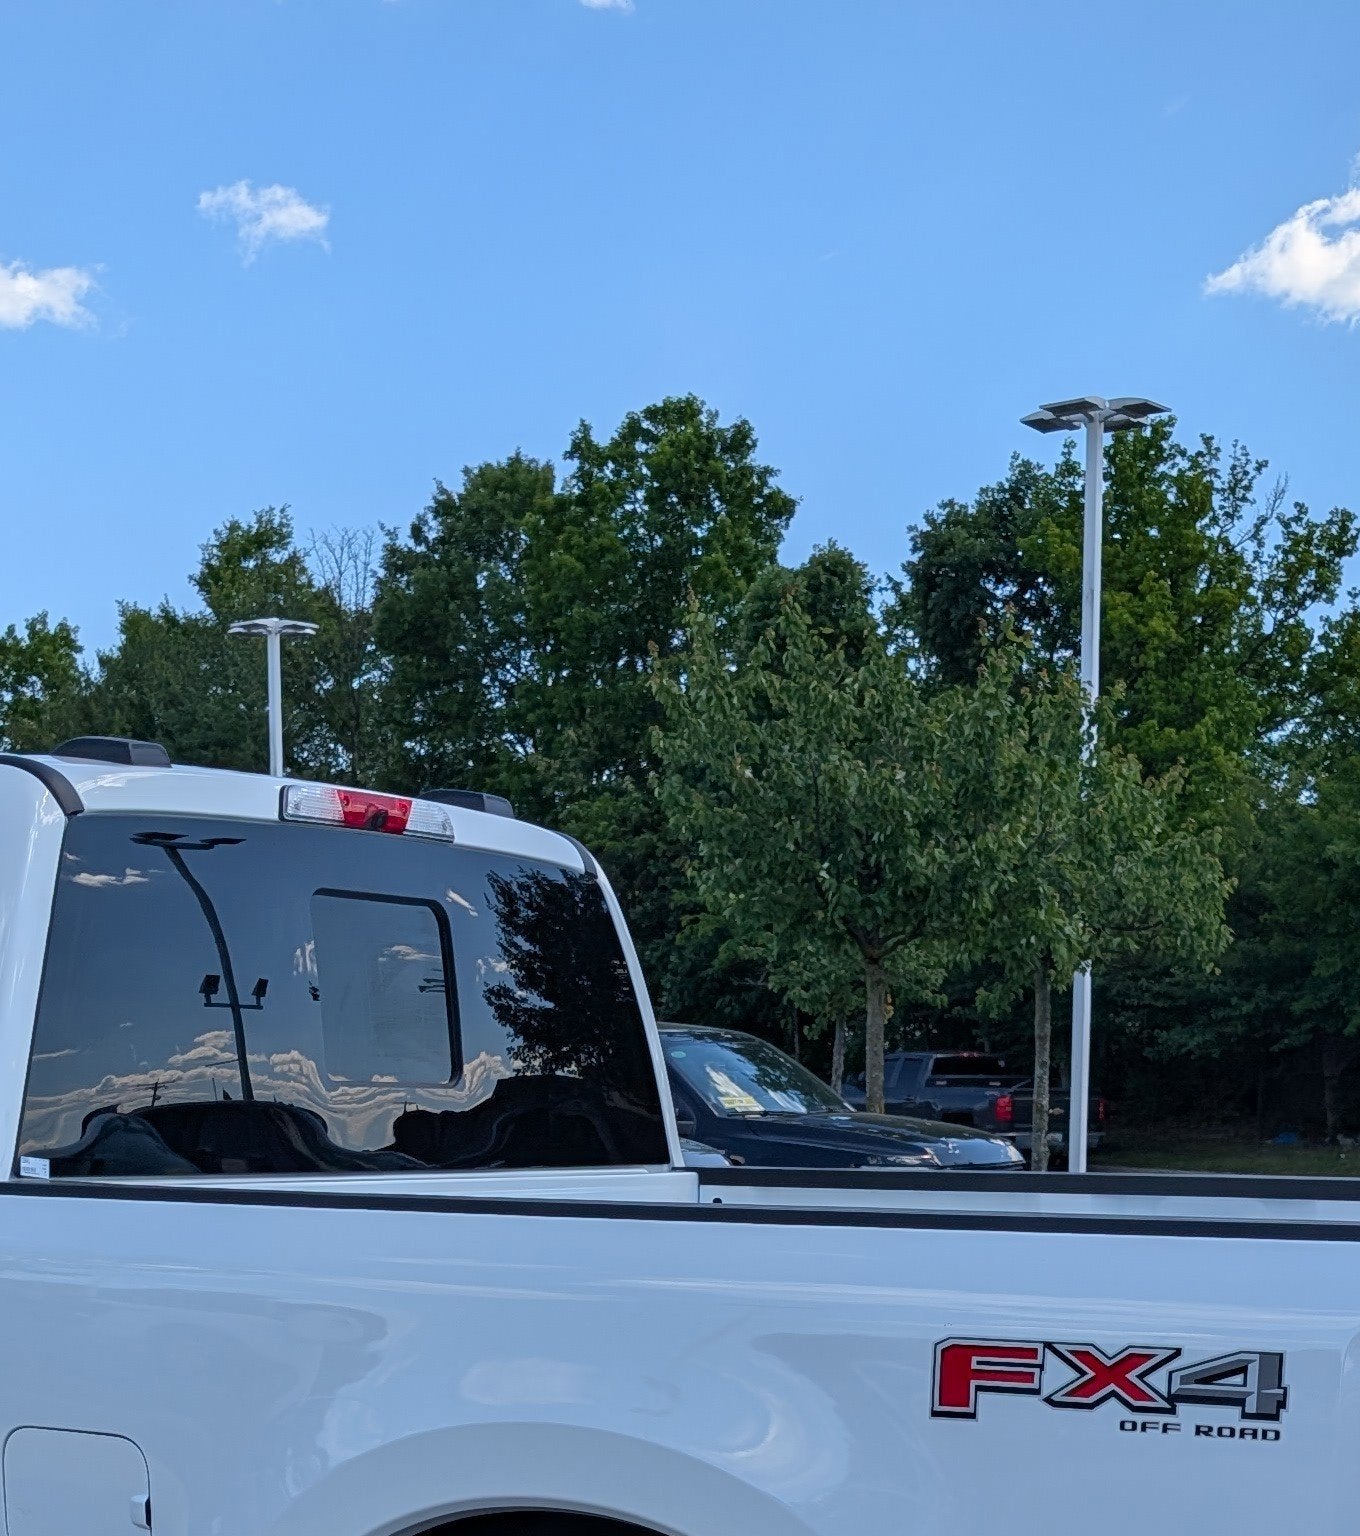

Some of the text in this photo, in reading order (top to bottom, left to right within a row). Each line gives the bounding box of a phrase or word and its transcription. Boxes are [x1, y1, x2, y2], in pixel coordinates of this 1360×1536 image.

[930, 1336, 1290, 1422] FX4
[1119, 1420, 1281, 1442] OFF ROAD
